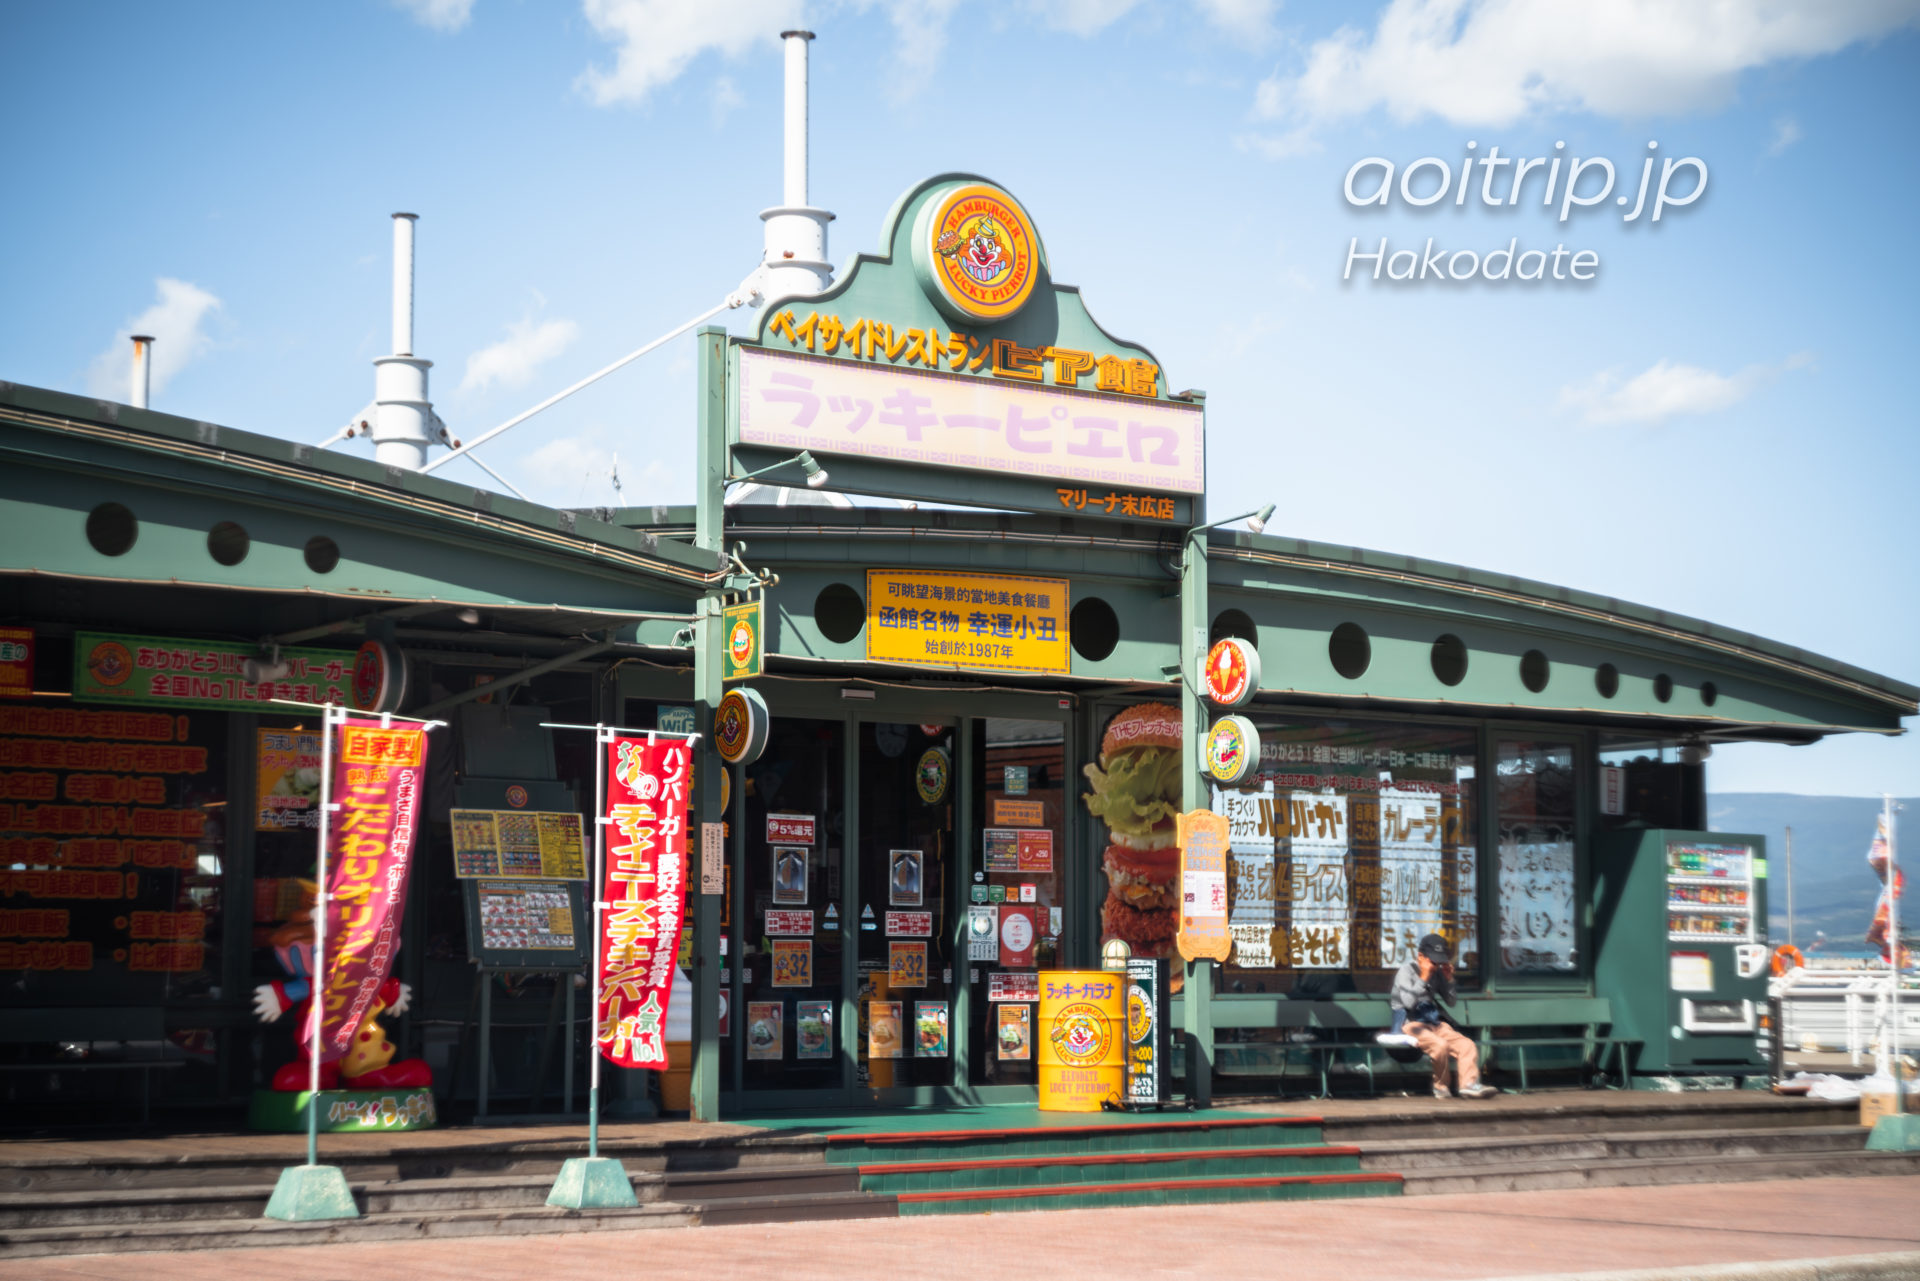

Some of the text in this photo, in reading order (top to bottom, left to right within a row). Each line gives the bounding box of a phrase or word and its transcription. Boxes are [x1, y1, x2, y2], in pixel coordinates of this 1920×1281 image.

[948, 200, 1020, 239] HAMBURGER
[949, 251, 1027, 301] LUCKY PIERROT
[759, 371, 1181, 467] ラッキーピエロ
[1056, 487, 1176, 521] マリーナ末広店
[887, 581, 1051, 610] 可眺望海景的當地美食餐廳
[878, 605, 1059, 642] 函館名物 幸運小丑
[924, 638, 1014, 660] 始創於1987年
[350, 734, 416, 760] 自家製
[1227, 798, 1344, 840] 手づくり ハンバーガー
[1229, 860, 1255, 882] Big
[1257, 862, 1344, 901] オムライス
[1229, 926, 1266, 944] 本の国民食
[1269, 925, 1345, 967] 焼きそば
[789, 952, 808, 977] 32
[906, 954, 923, 978] 32
[1046, 983, 1115, 999] ラッキーガラナ
[631, 991, 664, 1063] 人気 No.1
[1057, 1005, 1107, 1025] HAMBURGER
[1057, 1034, 1110, 1065] LUCKY PIERROT
[1050, 1082, 1111, 1094] LUCKY PIERROT
[1061, 1070, 1099, 1082] HAKODATE
